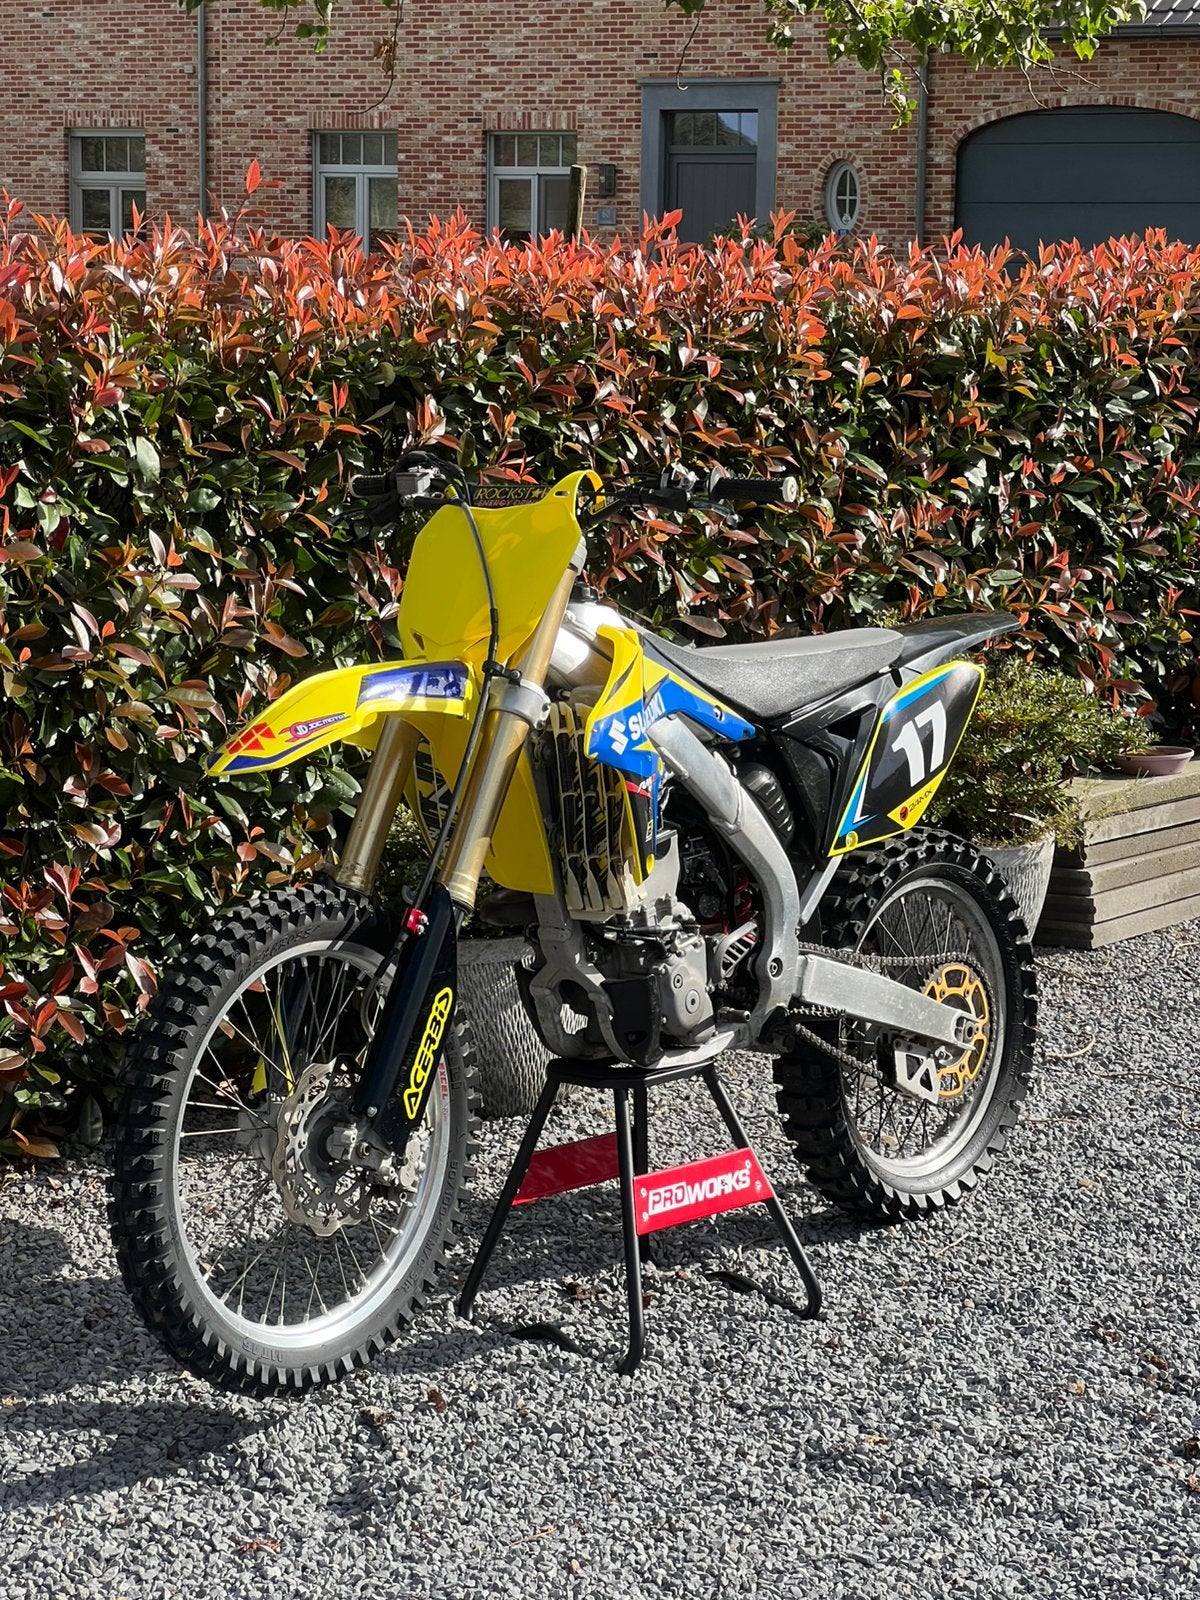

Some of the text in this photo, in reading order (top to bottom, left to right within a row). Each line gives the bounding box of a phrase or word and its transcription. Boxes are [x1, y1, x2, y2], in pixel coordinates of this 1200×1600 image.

[628, 691, 666, 741] SUZUKI
[891, 699, 947, 788] 17
[405, 988, 453, 1119] ACERBIS
[438, 1062, 449, 1100] EXCEL
